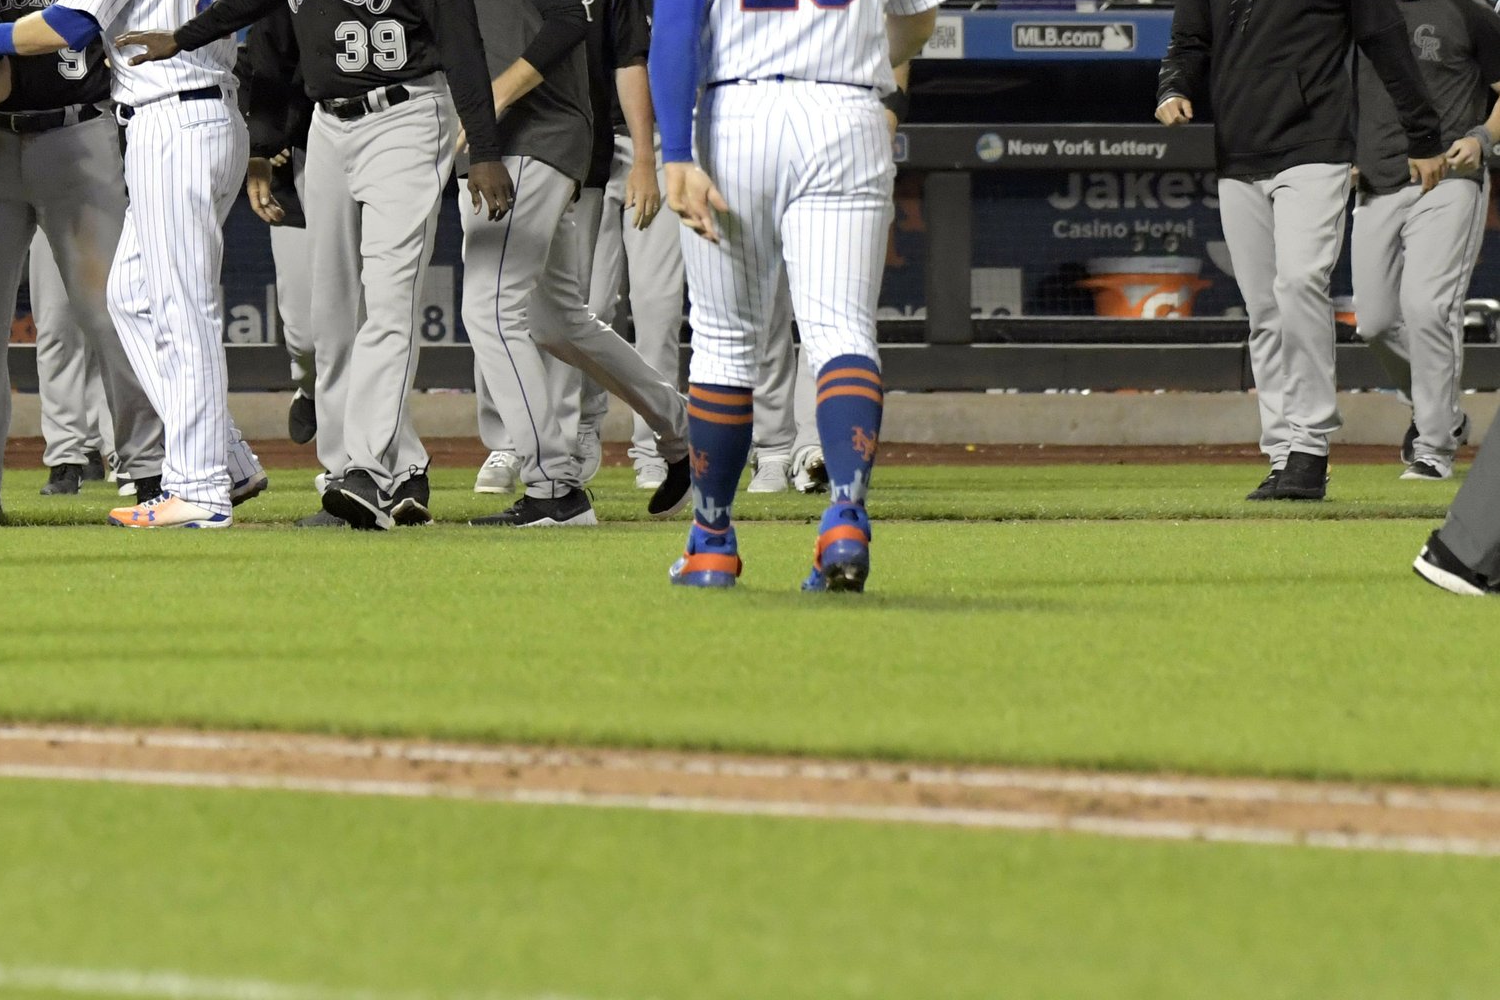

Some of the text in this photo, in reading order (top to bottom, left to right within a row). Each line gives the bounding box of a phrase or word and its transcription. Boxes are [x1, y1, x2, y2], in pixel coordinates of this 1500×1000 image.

[334, 19, 408, 73] 39
[1017, 27, 1100, 47] MLB.com
[1008, 140, 1167, 159] New York Lottery
[1053, 220, 1128, 239] Casino
